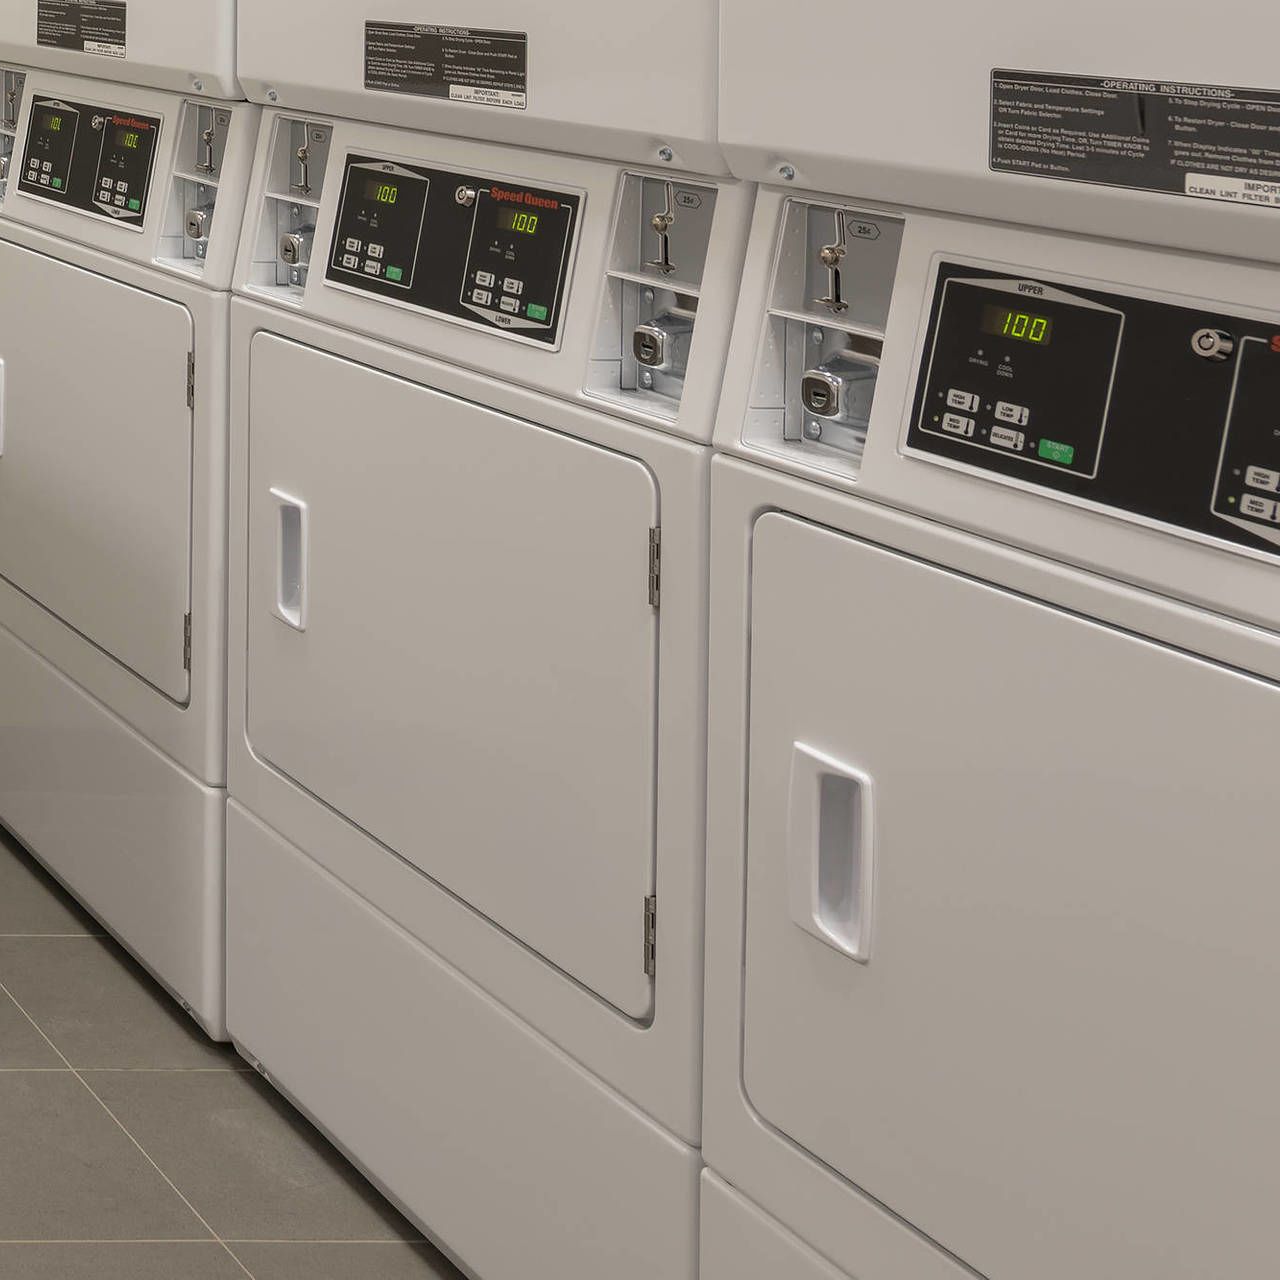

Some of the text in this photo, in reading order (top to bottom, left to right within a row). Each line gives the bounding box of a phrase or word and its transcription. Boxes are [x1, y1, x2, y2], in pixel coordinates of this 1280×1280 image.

[377, 186, 397, 204] 100
[491, 187, 559, 210] Speed Queen
[1188, 186, 1216, 196] CLEAN
[512, 213, 538, 234] 100
[1018, 283, 1044, 296] UPPER
[1003, 313, 1047, 342] 100
